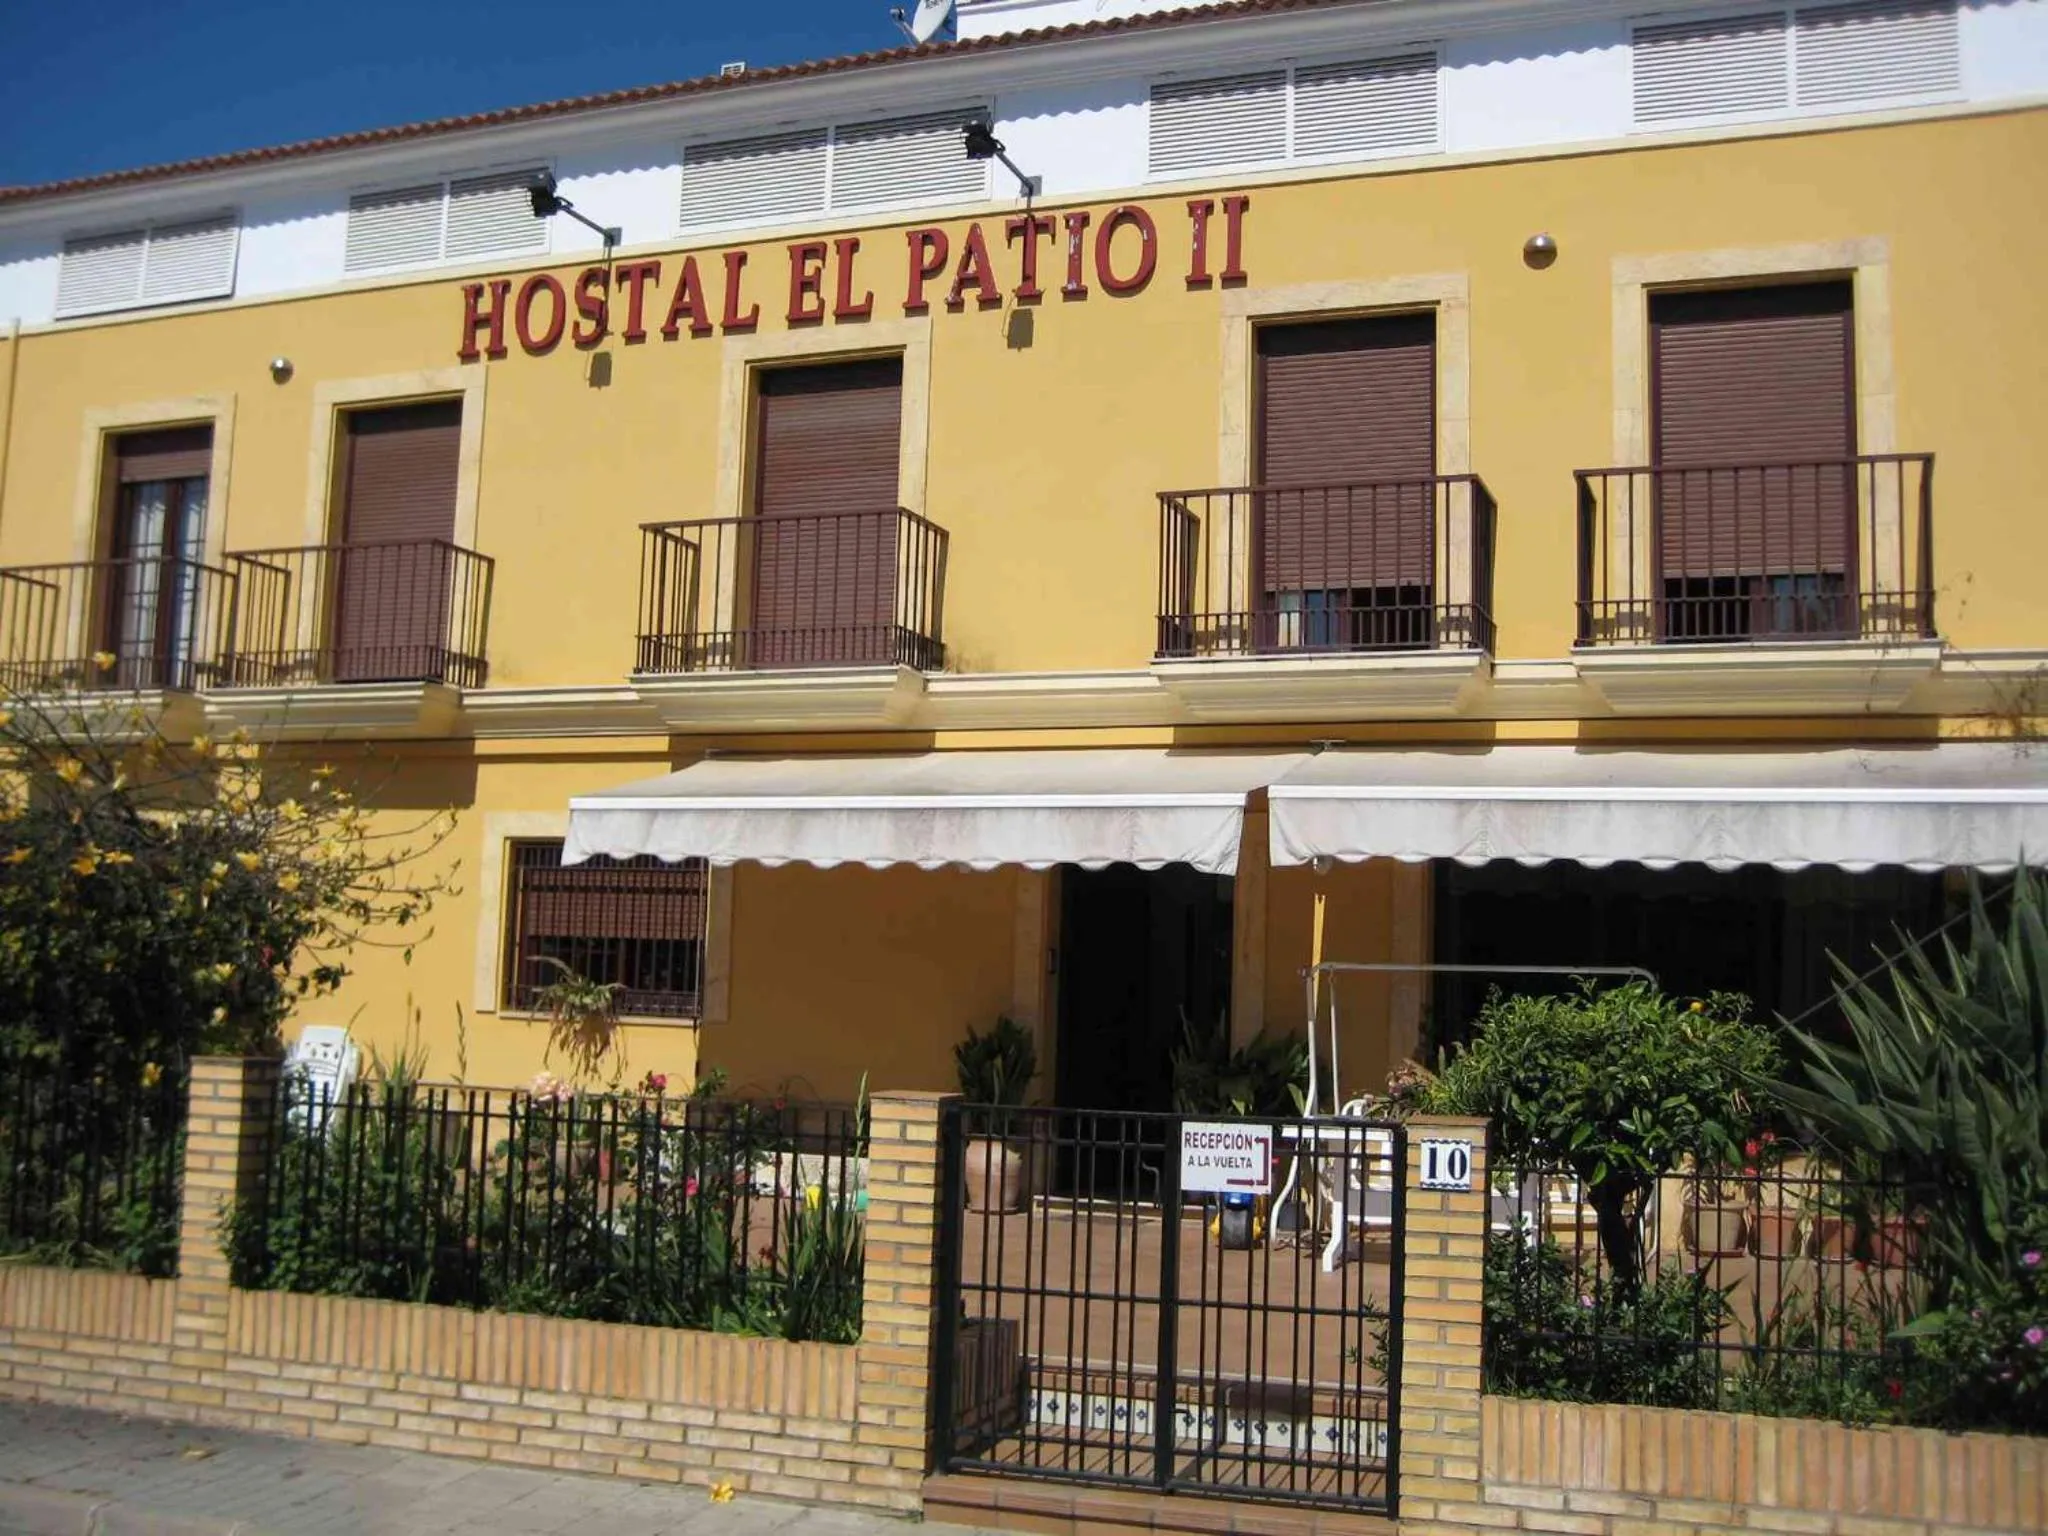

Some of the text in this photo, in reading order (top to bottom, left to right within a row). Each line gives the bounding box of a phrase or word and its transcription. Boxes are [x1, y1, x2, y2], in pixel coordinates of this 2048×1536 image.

[458, 195, 1250, 358] HOSTAL EL PATIO II
[1184, 1130, 1253, 1150] RECEPCIÓN
[1188, 1155, 1253, 1170] A LA VUELTA
[1427, 1146, 1468, 1180] 10
